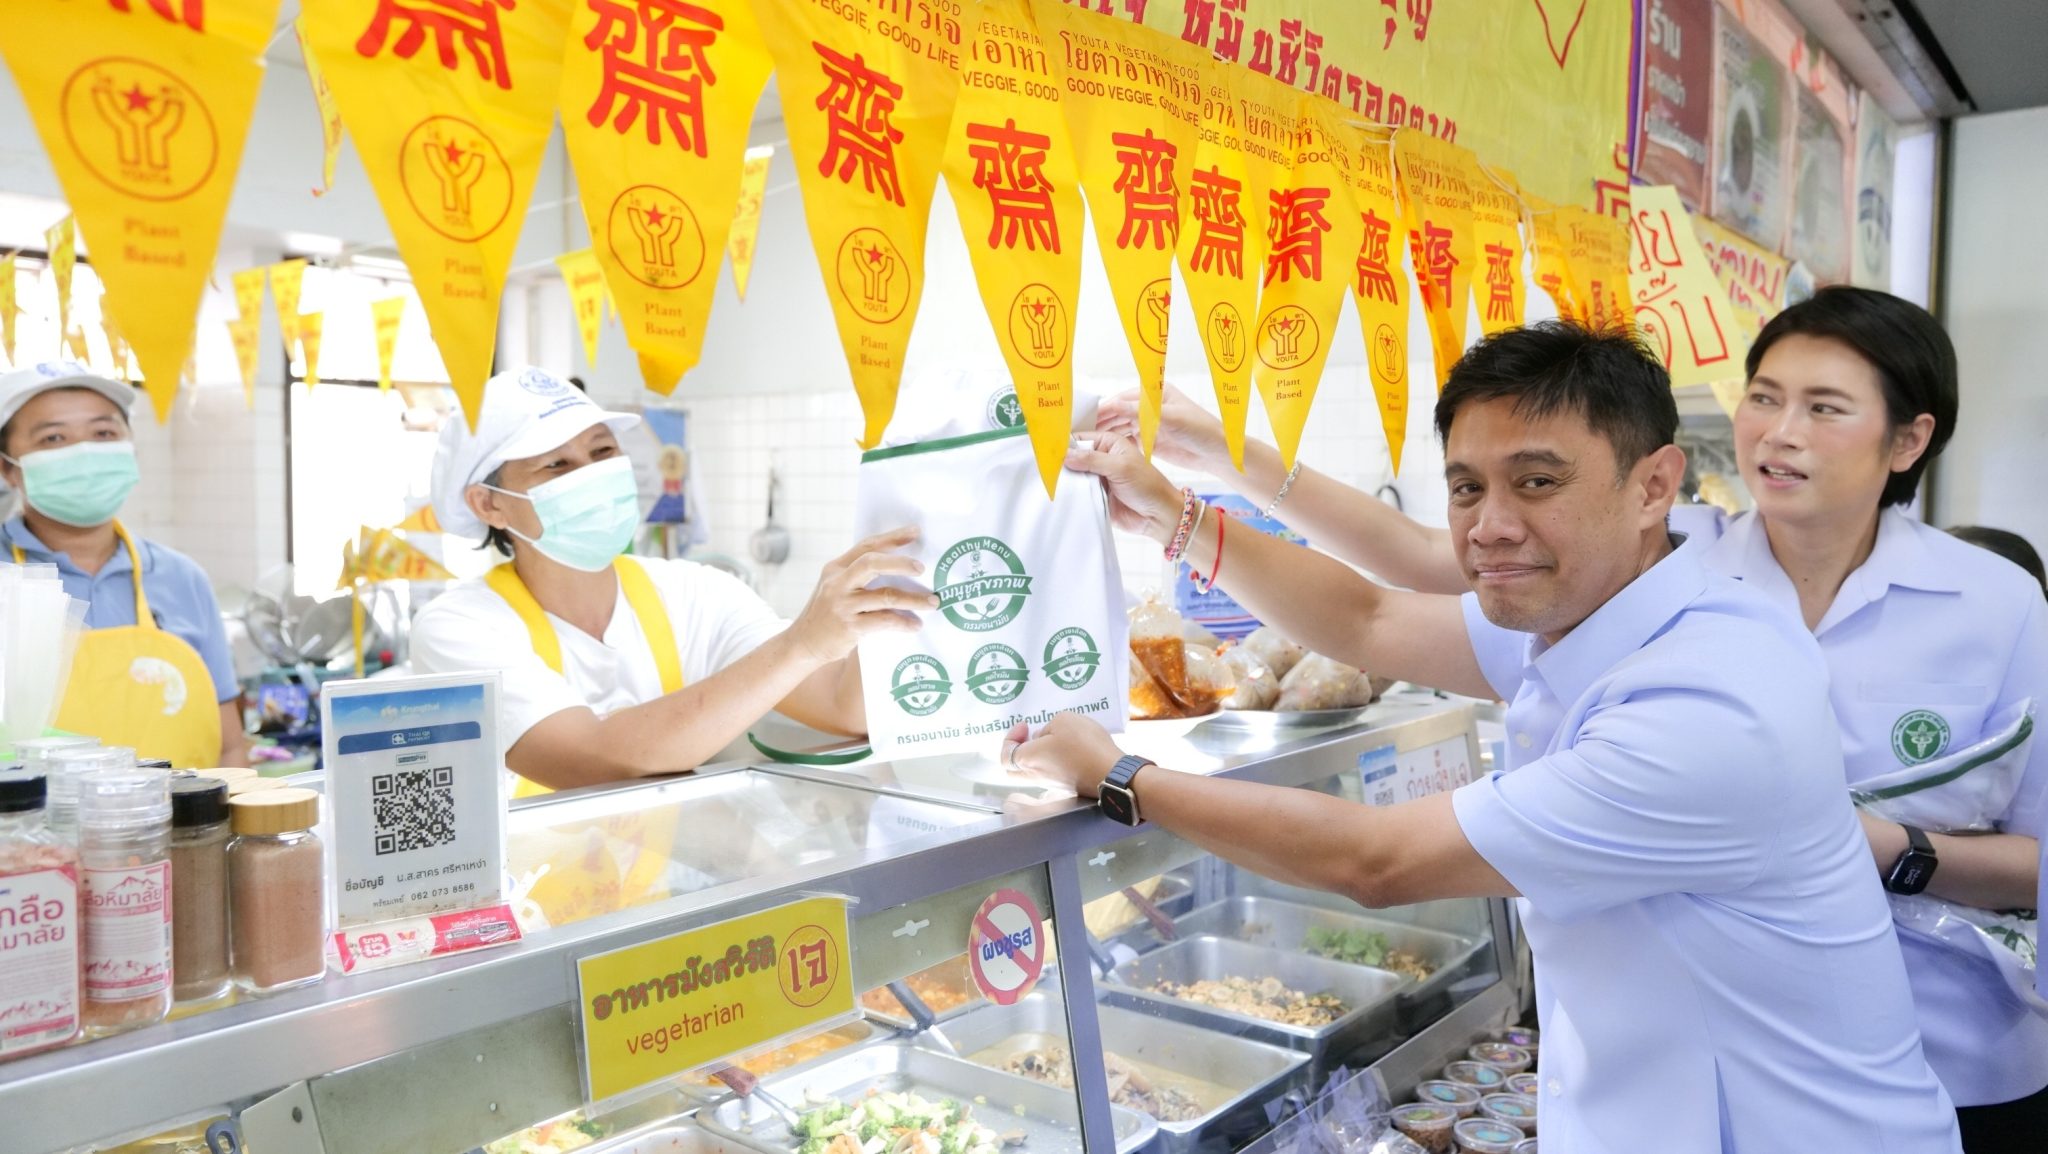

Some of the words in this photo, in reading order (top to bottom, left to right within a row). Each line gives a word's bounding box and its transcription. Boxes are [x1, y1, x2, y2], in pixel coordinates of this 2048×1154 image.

[877, 20, 921, 54] GOOD
[927, 42, 959, 70] LIFE
[1073, 32, 1110, 51] YOUTA
[1116, 41, 1172, 71] VEGETARIAN
[1059, 30, 1201, 105] โยตาอาหารเจ
[963, 71, 1021, 97] VEGGIE,
[1025, 81, 1059, 102] GOOD
[1067, 77, 1105, 97] GOOD
[1108, 84, 1157, 109] VEGGIE,
[1159, 95, 1180, 118] GOOD
[1181, 108, 1199, 127] LIFE
[814, 40, 906, 208] 齋
[966, 118, 1061, 255] 齋
[644, 302, 682, 318] Plant
[863, 302, 889, 314] YOUTA
[645, 322, 686, 339] Based
[861, 335, 888, 351] Plant
[860, 353, 891, 370] Based
[1033, 351, 1055, 359] YOUTA
[1276, 354, 1299, 364] YOUTA
[1037, 380, 1060, 392] Plant
[1277, 379, 1300, 388] Plant
[1038, 397, 1064, 409] Based
[1276, 390, 1303, 401] Based
[939, 540, 981, 573] Healthy
[983, 538, 1011, 560] Menu
[939, 576, 1026, 601] เมนูชูสุขภาพ
[897, 728, 961, 745] กรมอนามัย
[345, 876, 384, 892] ชื่อบัญชี
[411, 892, 428, 901] 062
[432, 887, 449, 898] 073
[592, 935, 777, 1021] อาหารมังสวิรัติ
[787, 938, 829, 993] เจ
[626, 1002, 745, 1055] vegetarian
